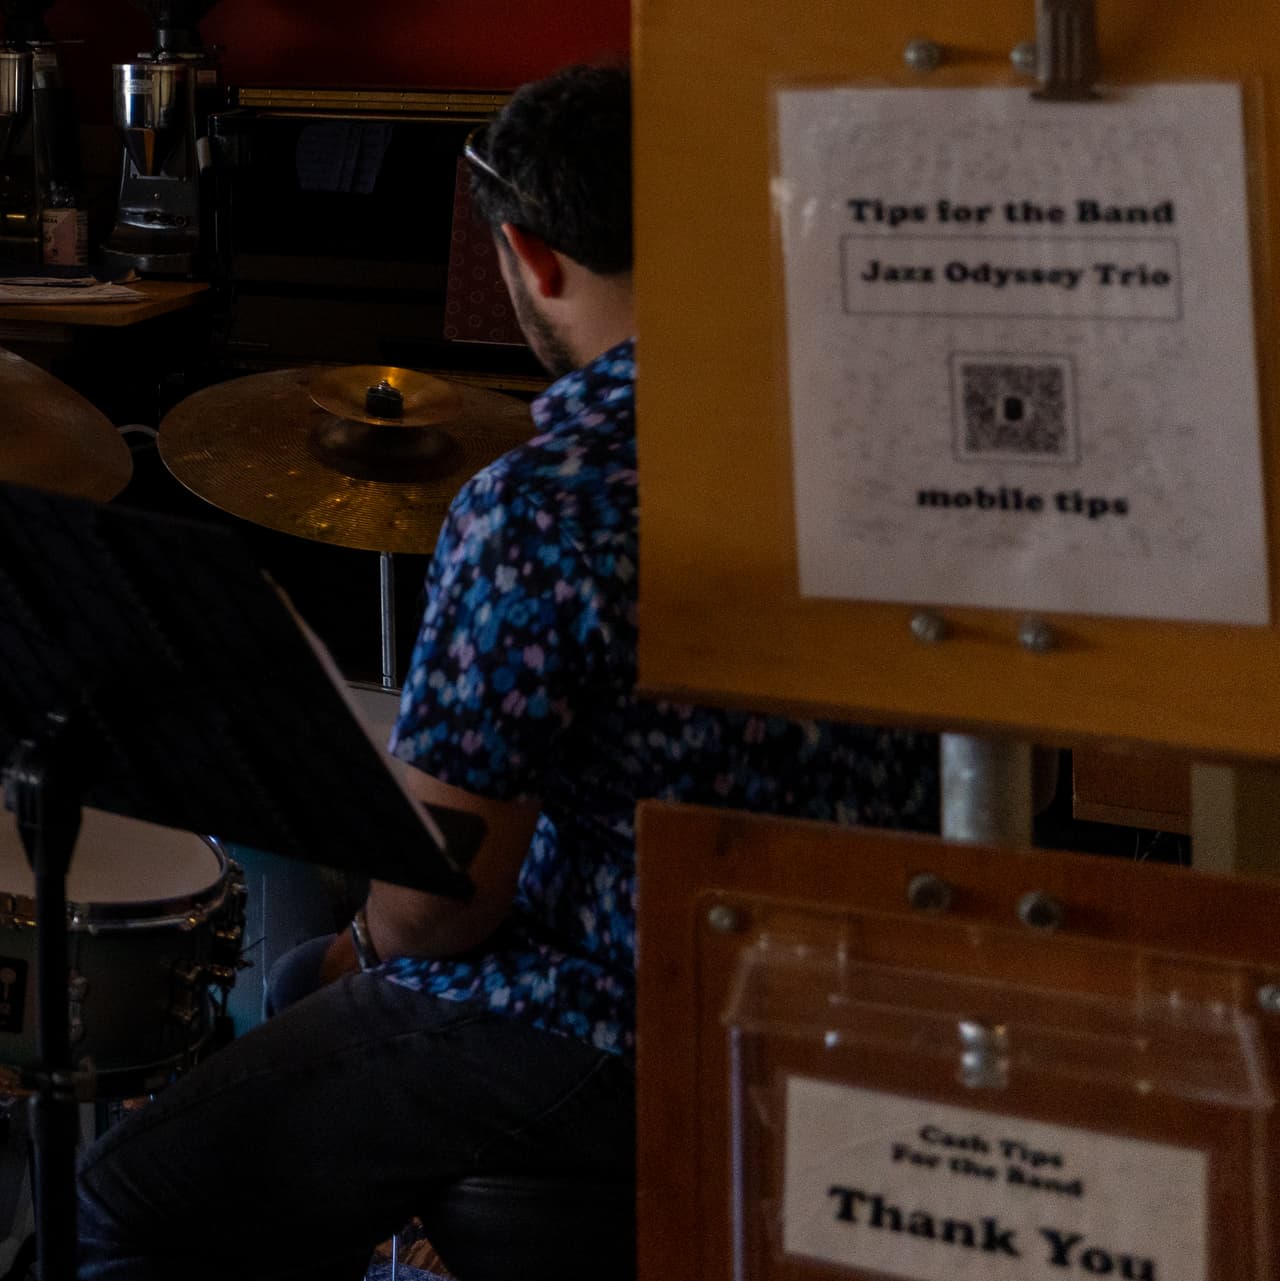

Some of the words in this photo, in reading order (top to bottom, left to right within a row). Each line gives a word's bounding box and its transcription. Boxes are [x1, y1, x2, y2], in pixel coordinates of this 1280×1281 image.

[847, 199, 925, 227] Tips
[936, 199, 993, 224] for
[1004, 200, 1066, 225] the
[1076, 199, 1176, 225] Band
[860, 260, 934, 283] Jazz
[944, 261, 1082, 291] Odyssey
[1093, 263, 1172, 287] Trio
[916, 486, 1043, 511] mobile
[1054, 491, 1130, 519] tips
[919, 1123, 990, 1155] Cash
[1000, 1138, 1063, 1169] Tips
[890, 1142, 941, 1169] For
[949, 1158, 998, 1181] the
[1006, 1166, 1084, 1198] Band
[826, 1183, 1023, 1260] Thank
[1036, 1224, 1157, 1281] You
